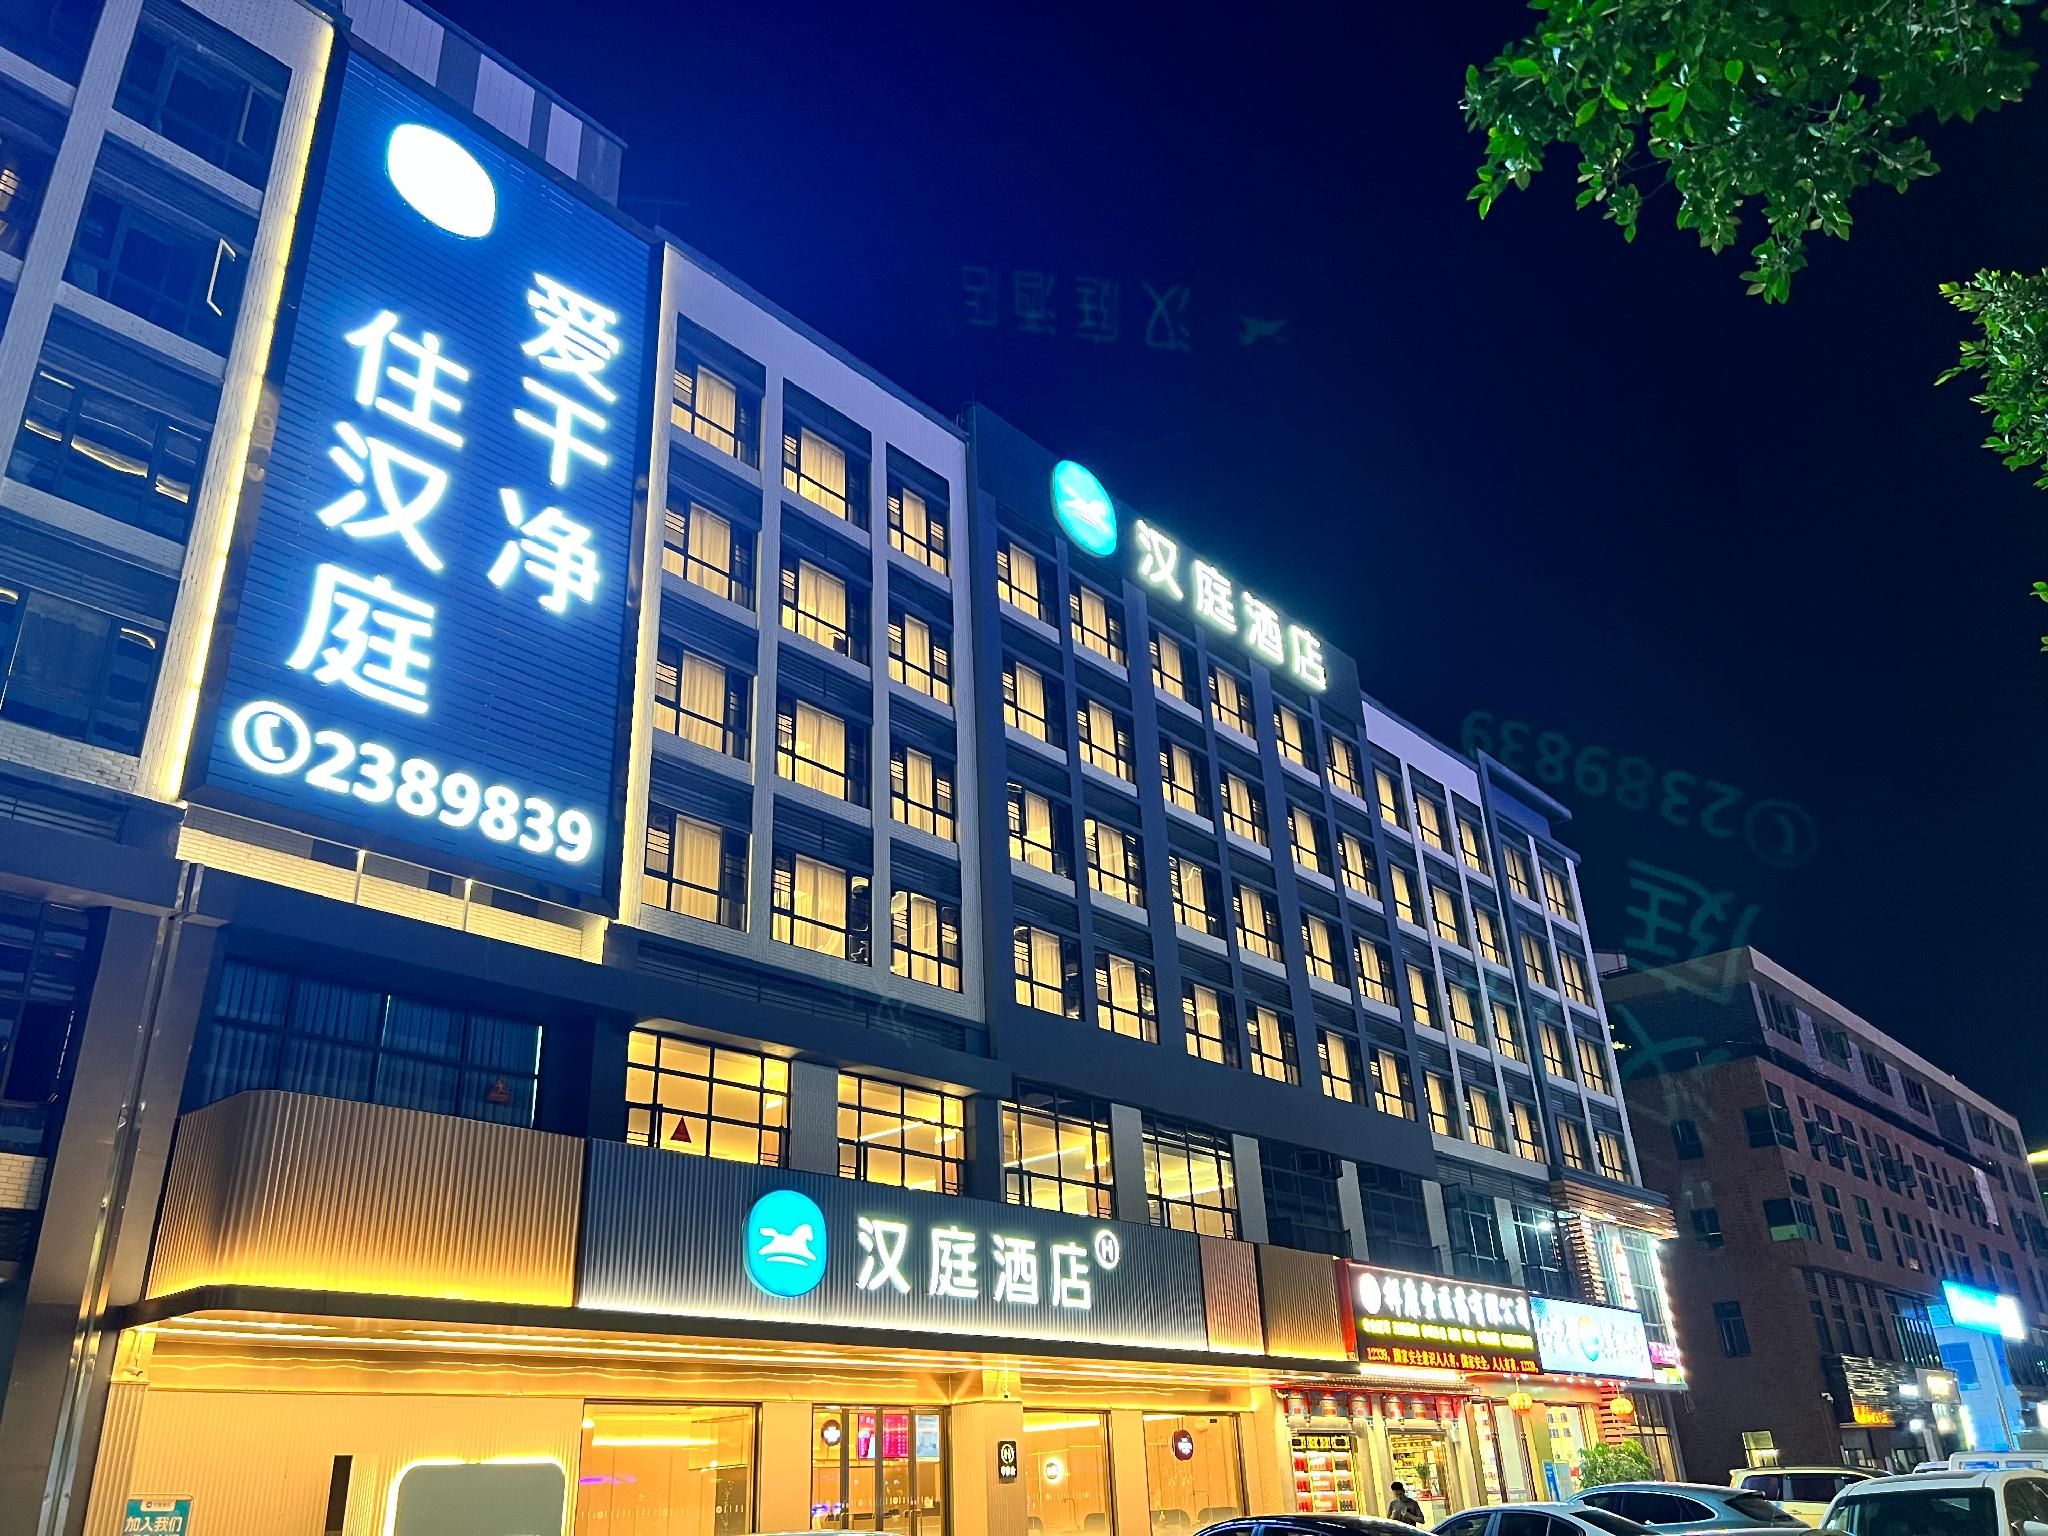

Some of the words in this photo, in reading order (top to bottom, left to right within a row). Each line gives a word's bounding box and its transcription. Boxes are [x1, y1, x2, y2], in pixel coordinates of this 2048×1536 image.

[286, 309, 472, 715] 住汉庭
[487, 272, 624, 616] 爱干净
[1136, 519, 1327, 692] 汉庭酒店
[304, 730, 596, 865] 2389839
[855, 1215, 1092, 1311] 汉庭酒店
[124, 1516, 183, 1533] 加入我们
